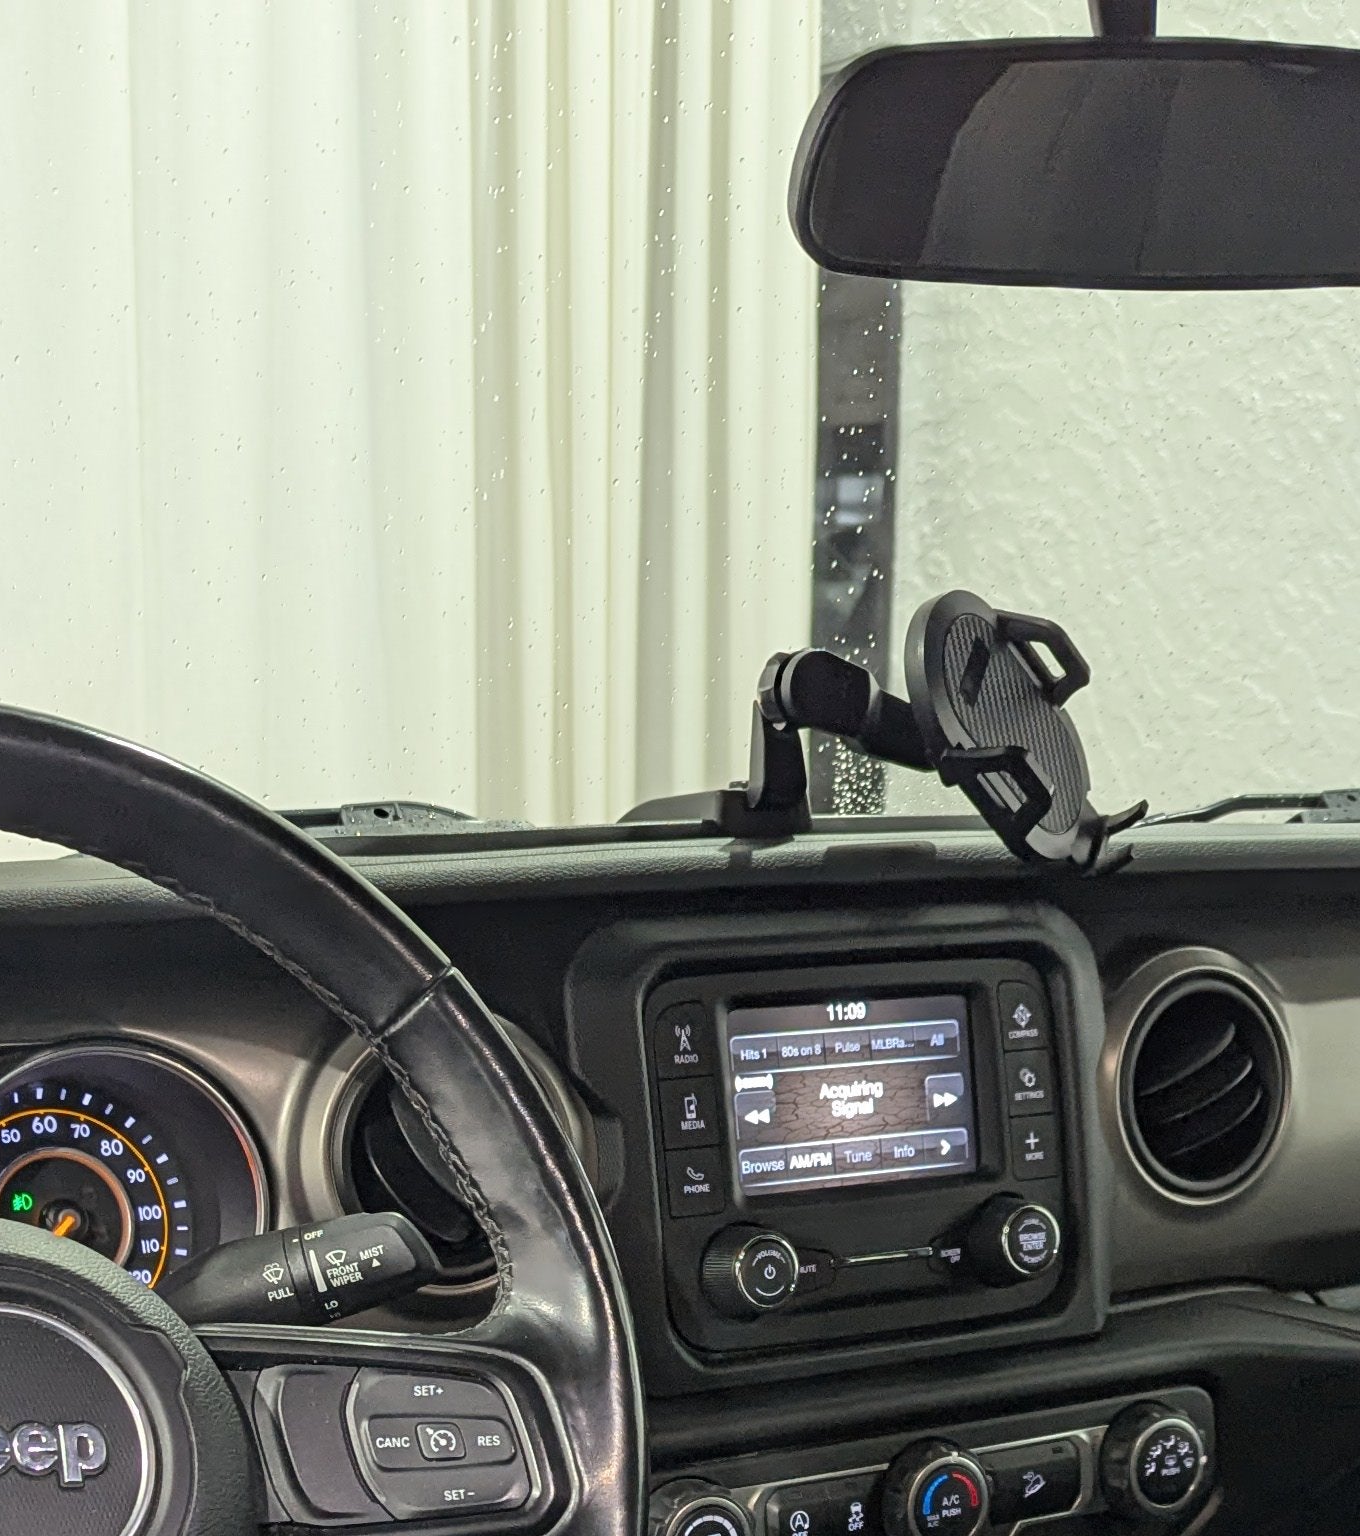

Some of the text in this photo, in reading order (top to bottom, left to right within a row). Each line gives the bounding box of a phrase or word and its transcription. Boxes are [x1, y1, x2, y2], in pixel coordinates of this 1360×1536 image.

[826, 1002, 867, 1021] 11:09
[930, 1033, 944, 1047] All
[741, 1049, 760, 1060] Hits
[781, 1043, 821, 1057] 80s on 8
[835, 1042, 860, 1054] Pulse
[674, 1054, 699, 1064] RADIO
[820, 1080, 884, 1101] Acquiring
[831, 1098, 874, 1119] Signal
[32, 1115, 58, 1134] 60
[70, 1123, 90, 1138] 70
[681, 1120, 705, 1131] MEDIA
[1, 1129, 21, 1143] 50
[100, 1139, 123, 1156] 80
[742, 1145, 915, 1175] Browse AM/FM Tune Info
[127, 1169, 146, 1183] 90
[684, 1183, 710, 1194] PHONE
[138, 1205, 162, 1221] 100
[304, 1229, 324, 1240] OFF
[141, 1238, 160, 1254] 110
[359, 1245, 384, 1260] MIST
[128, 1270, 152, 1284] 20
[326, 1262, 359, 1279] FRONT
[329, 1272, 364, 1288] WIPER
[267, 1287, 294, 1302] PULL
[324, 1300, 339, 1310] LO
[413, 1385, 444, 1397] SET+
[376, 1437, 410, 1449] CANC
[477, 1435, 500, 1447] RES
[942, 1494, 960, 1506] A/C
[942, 1508, 962, 1518] PUSH
[848, 1521, 864, 1532] OFF
